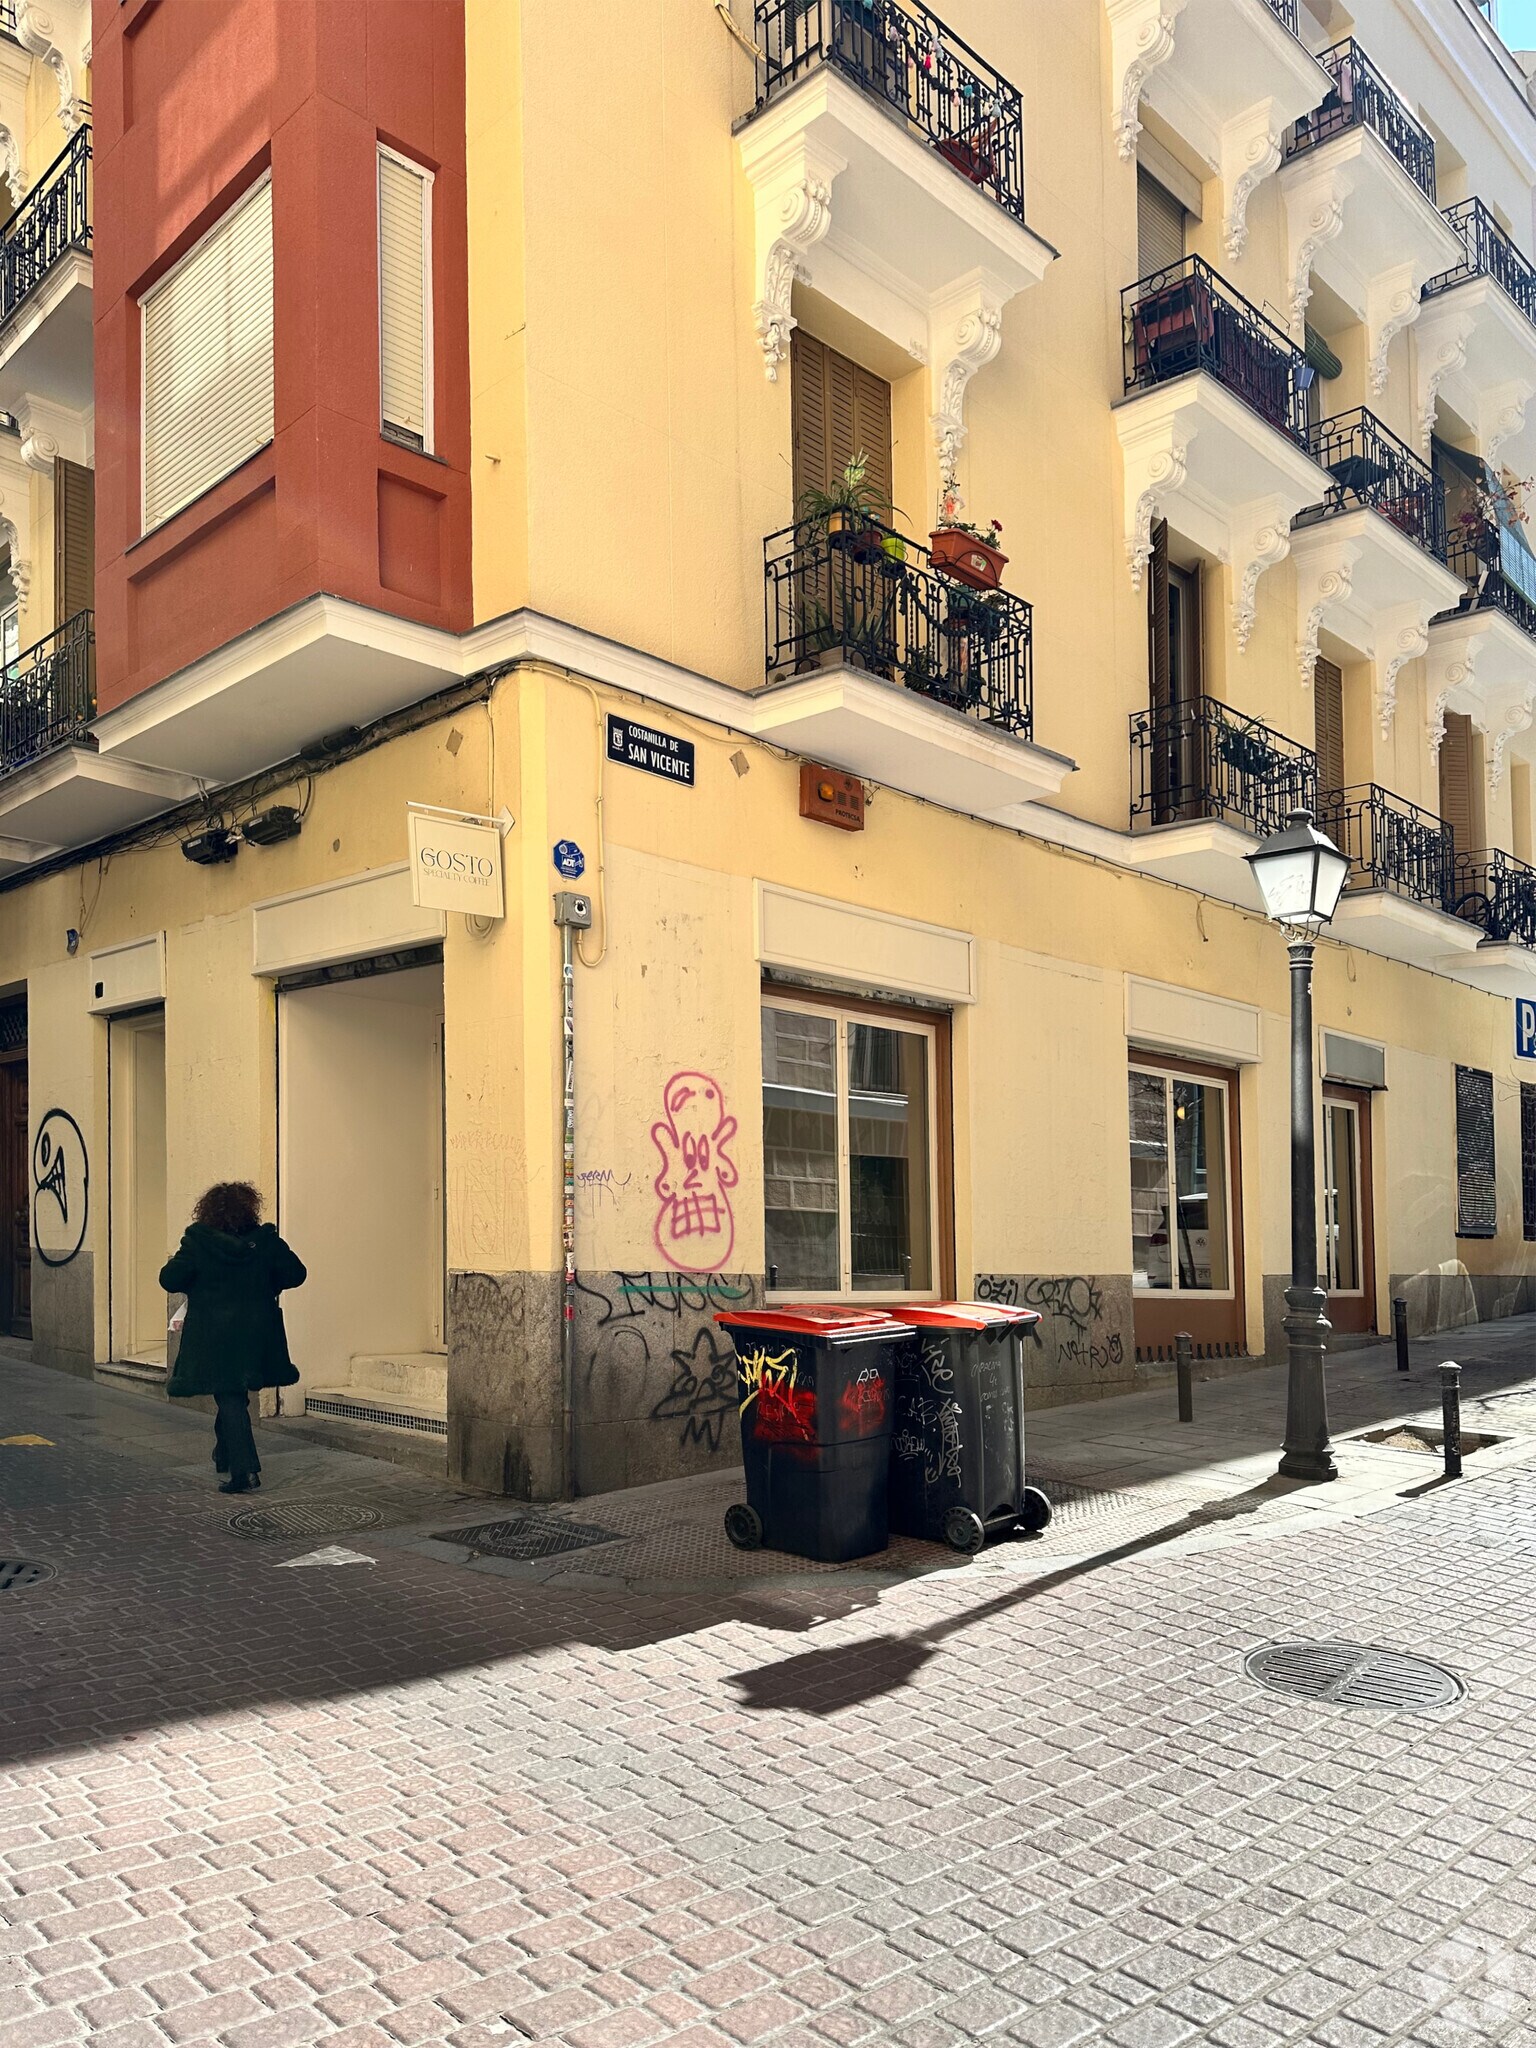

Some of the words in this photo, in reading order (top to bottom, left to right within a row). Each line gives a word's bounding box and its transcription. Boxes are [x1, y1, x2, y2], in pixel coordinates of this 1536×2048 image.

[628, 725, 667, 748] COSTANILLA
[669, 740, 679, 753] DE
[628, 743, 647, 764] SAN
[650, 750, 690, 779] VICENTE
[420, 847, 493, 877] GOSTO
[423, 867, 461, 882] SPECIALTY
[463, 875, 490, 886] COFFEE
[562, 858, 576, 867] ADT
[1521, 1002, 1536, 1052] P
